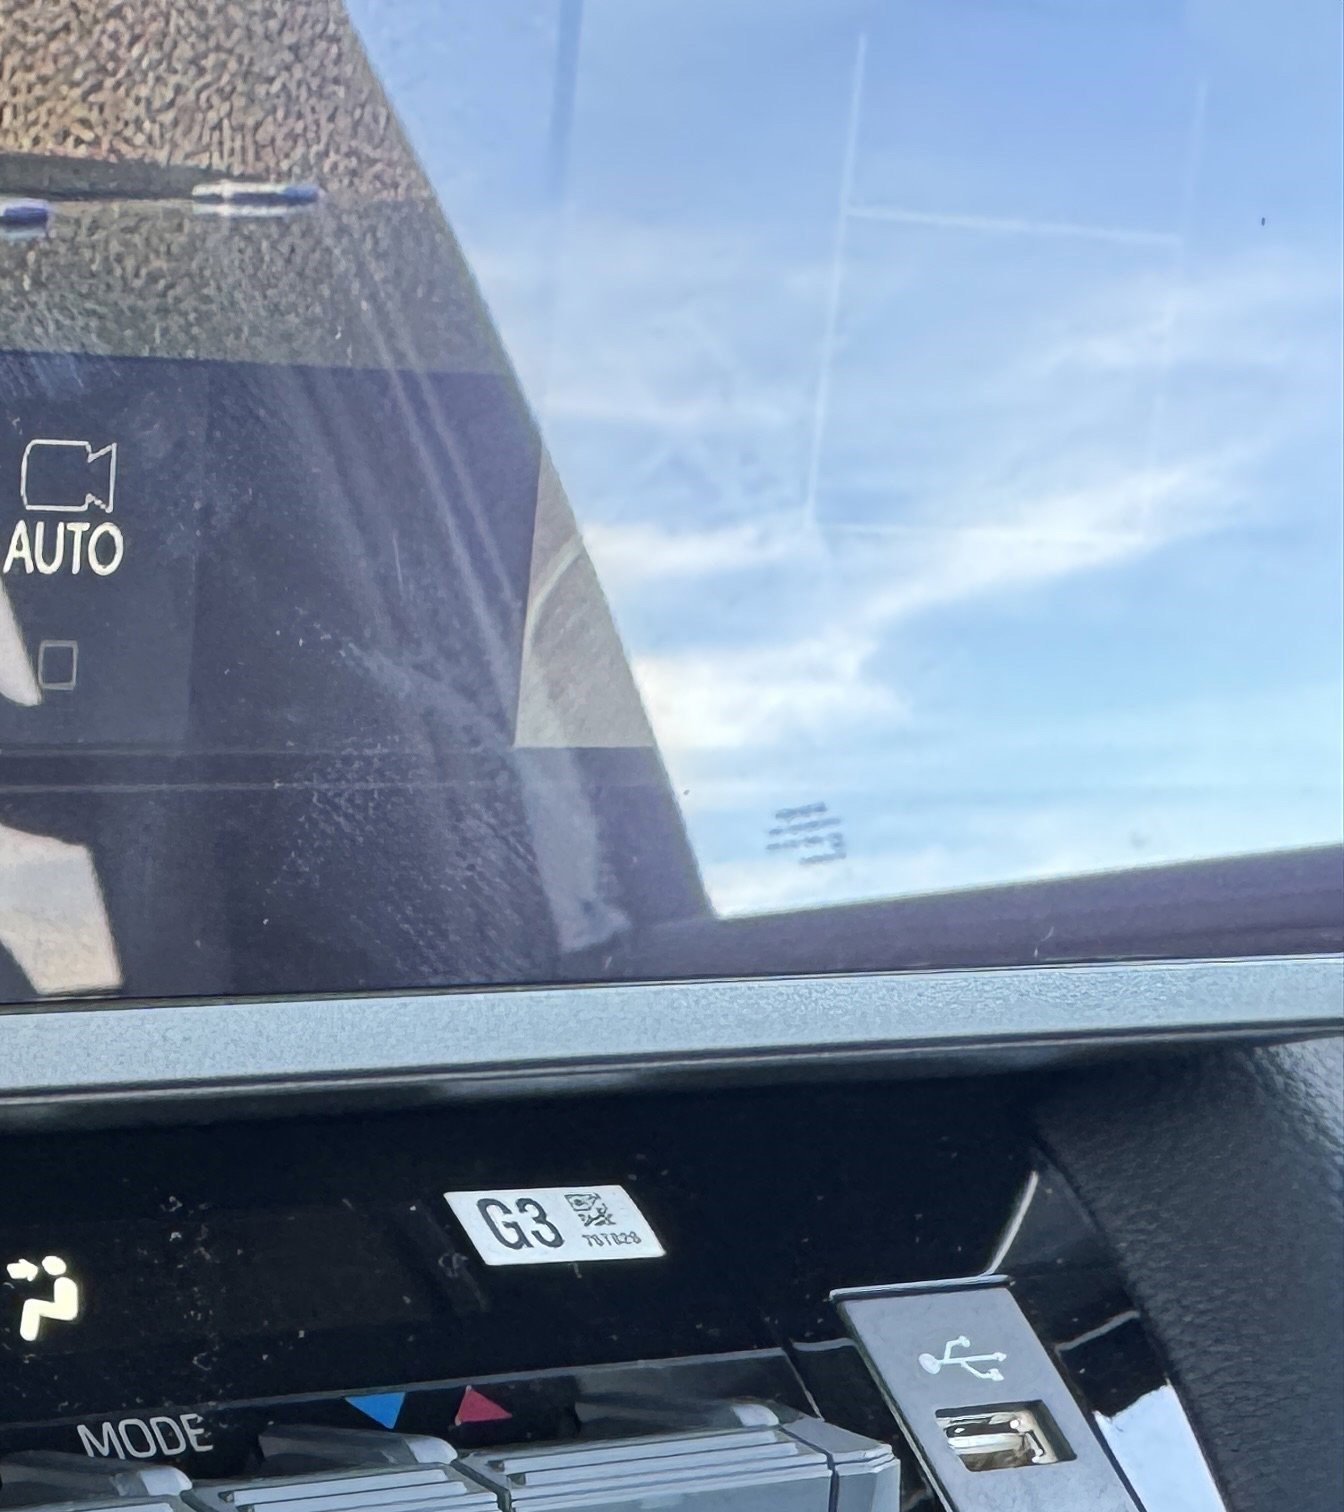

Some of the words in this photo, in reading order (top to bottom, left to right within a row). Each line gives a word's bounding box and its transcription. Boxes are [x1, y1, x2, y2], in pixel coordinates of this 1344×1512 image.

[3, 522, 124, 575] AUTO
[477, 1198, 564, 1250] G3
[77, 1413, 214, 1459] MODE
